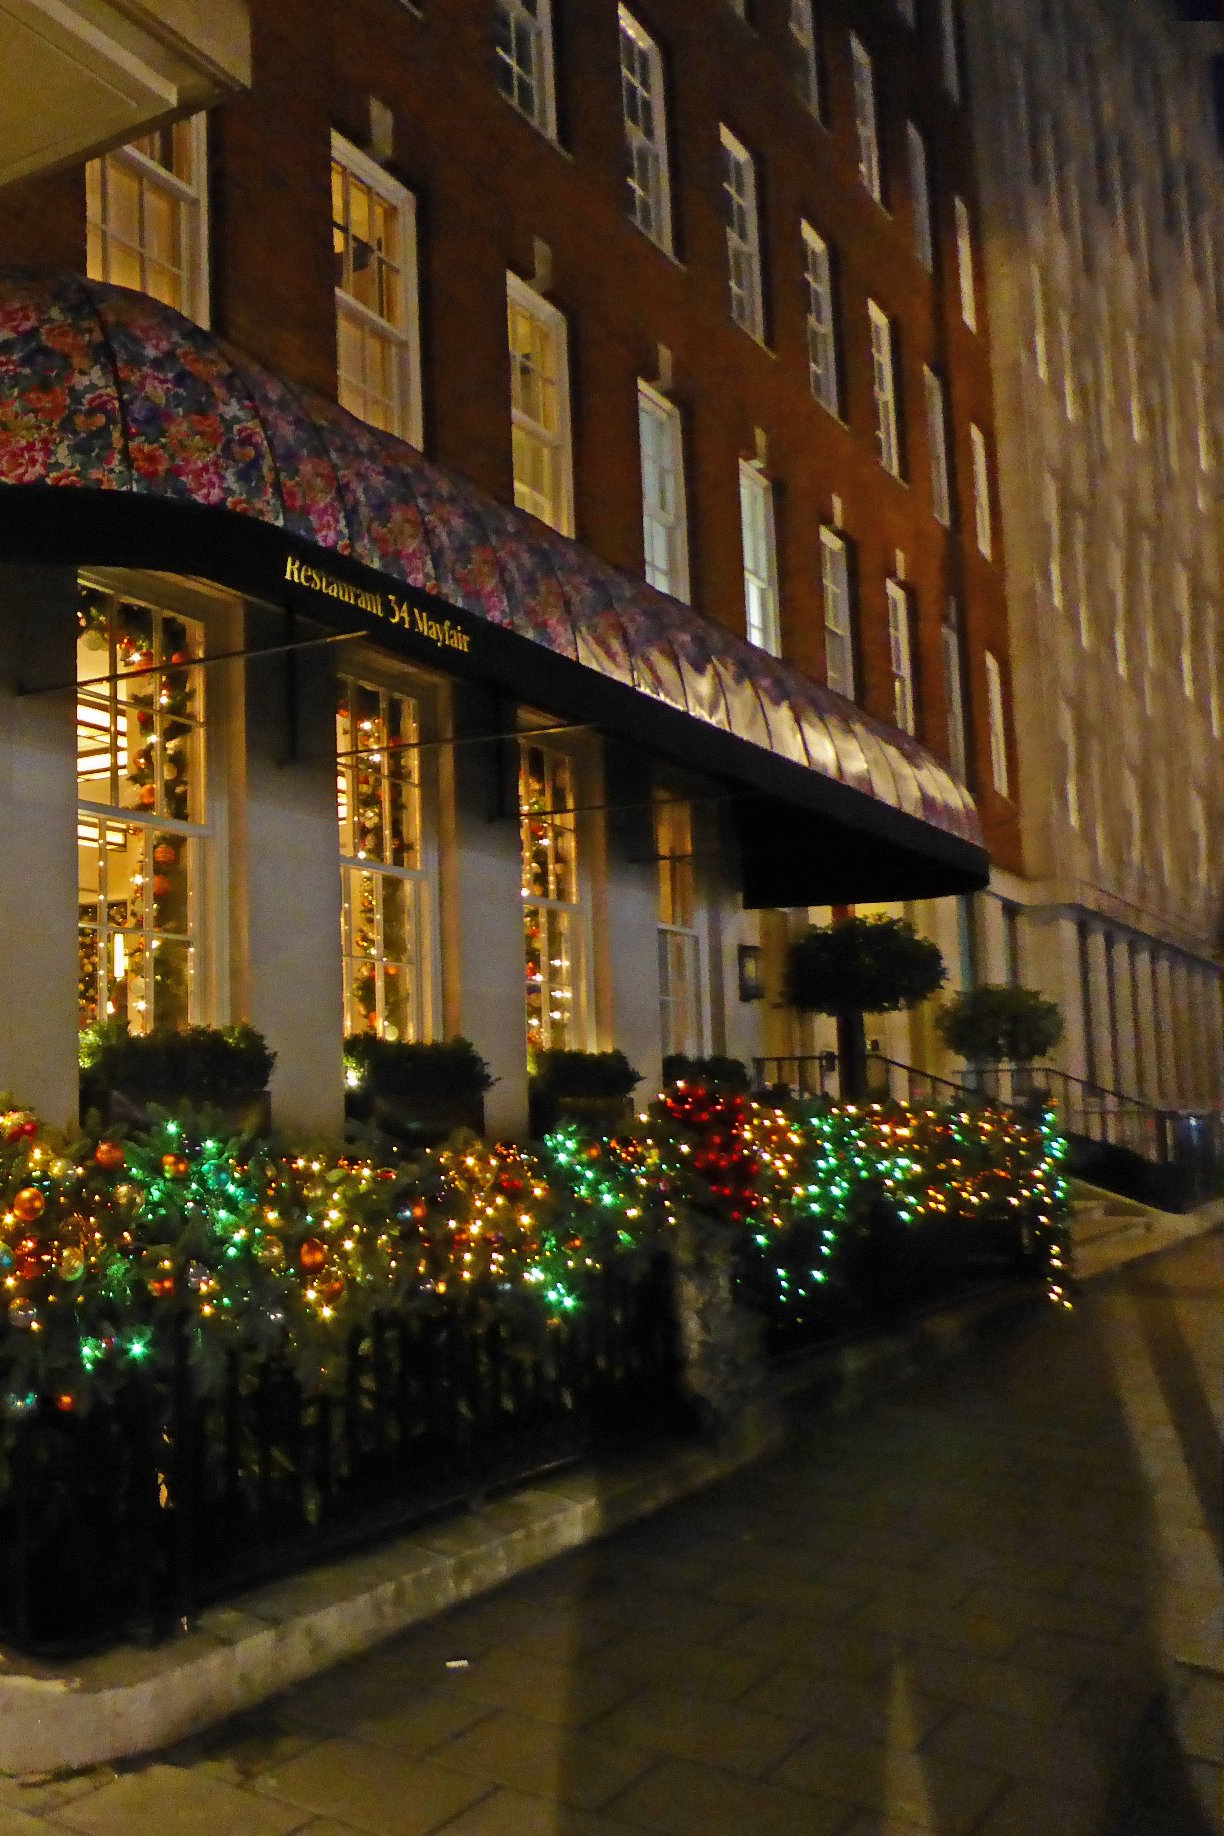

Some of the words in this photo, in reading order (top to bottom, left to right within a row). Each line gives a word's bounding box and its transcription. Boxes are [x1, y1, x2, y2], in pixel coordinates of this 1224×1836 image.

[284, 555, 384, 617] Restaurant
[388, 594, 410, 629] 34
[414, 607, 470, 652] Mayfair
